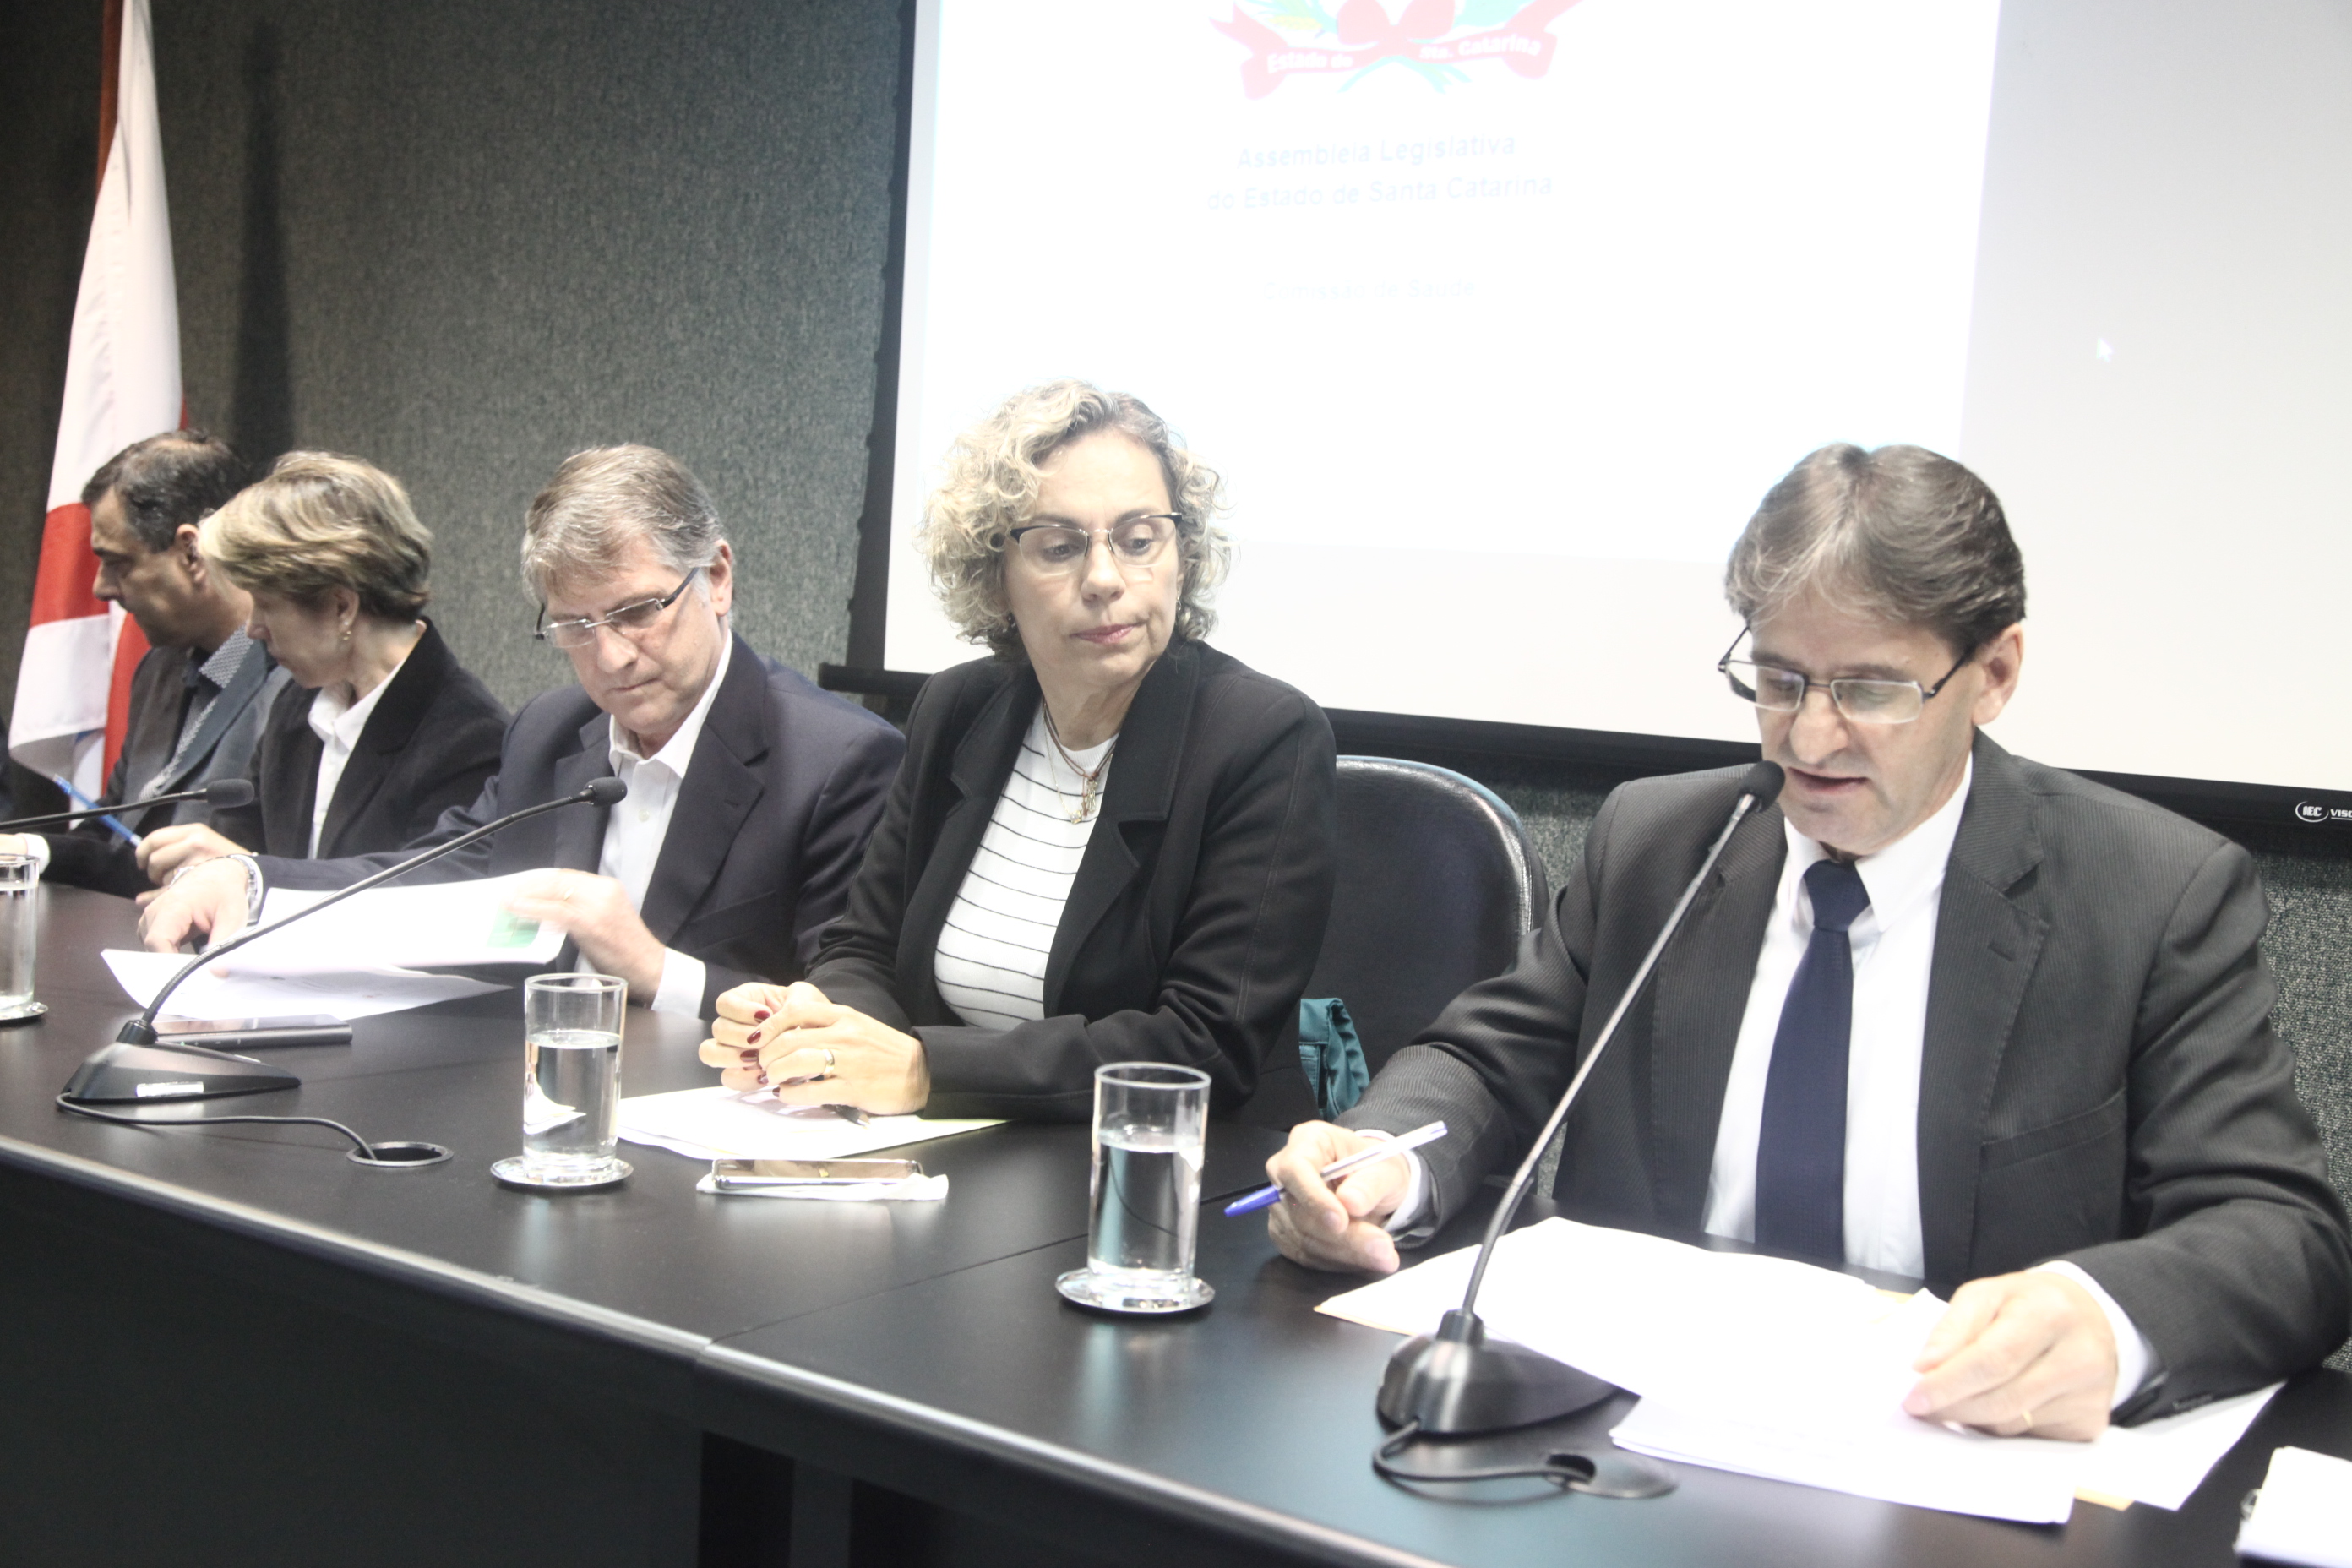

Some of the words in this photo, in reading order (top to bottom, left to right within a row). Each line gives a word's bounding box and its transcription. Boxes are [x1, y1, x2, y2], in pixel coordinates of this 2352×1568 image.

[1267, 52, 1327, 74] Estado
[1419, 46, 1453, 59] Sta.
[1457, 35, 1541, 57] Catarina
[1237, 144, 1371, 169] Assembleia
[1380, 133, 1516, 166] Legislativa
[1206, 190, 1235, 210] do
[1244, 185, 1323, 209] Estado
[1332, 184, 1360, 204] de
[1369, 180, 1438, 203] Santa
[1446, 174, 1553, 199] Catarina
[1374, 280, 1399, 298] de
[2302, 805, 2322, 817] IEC
